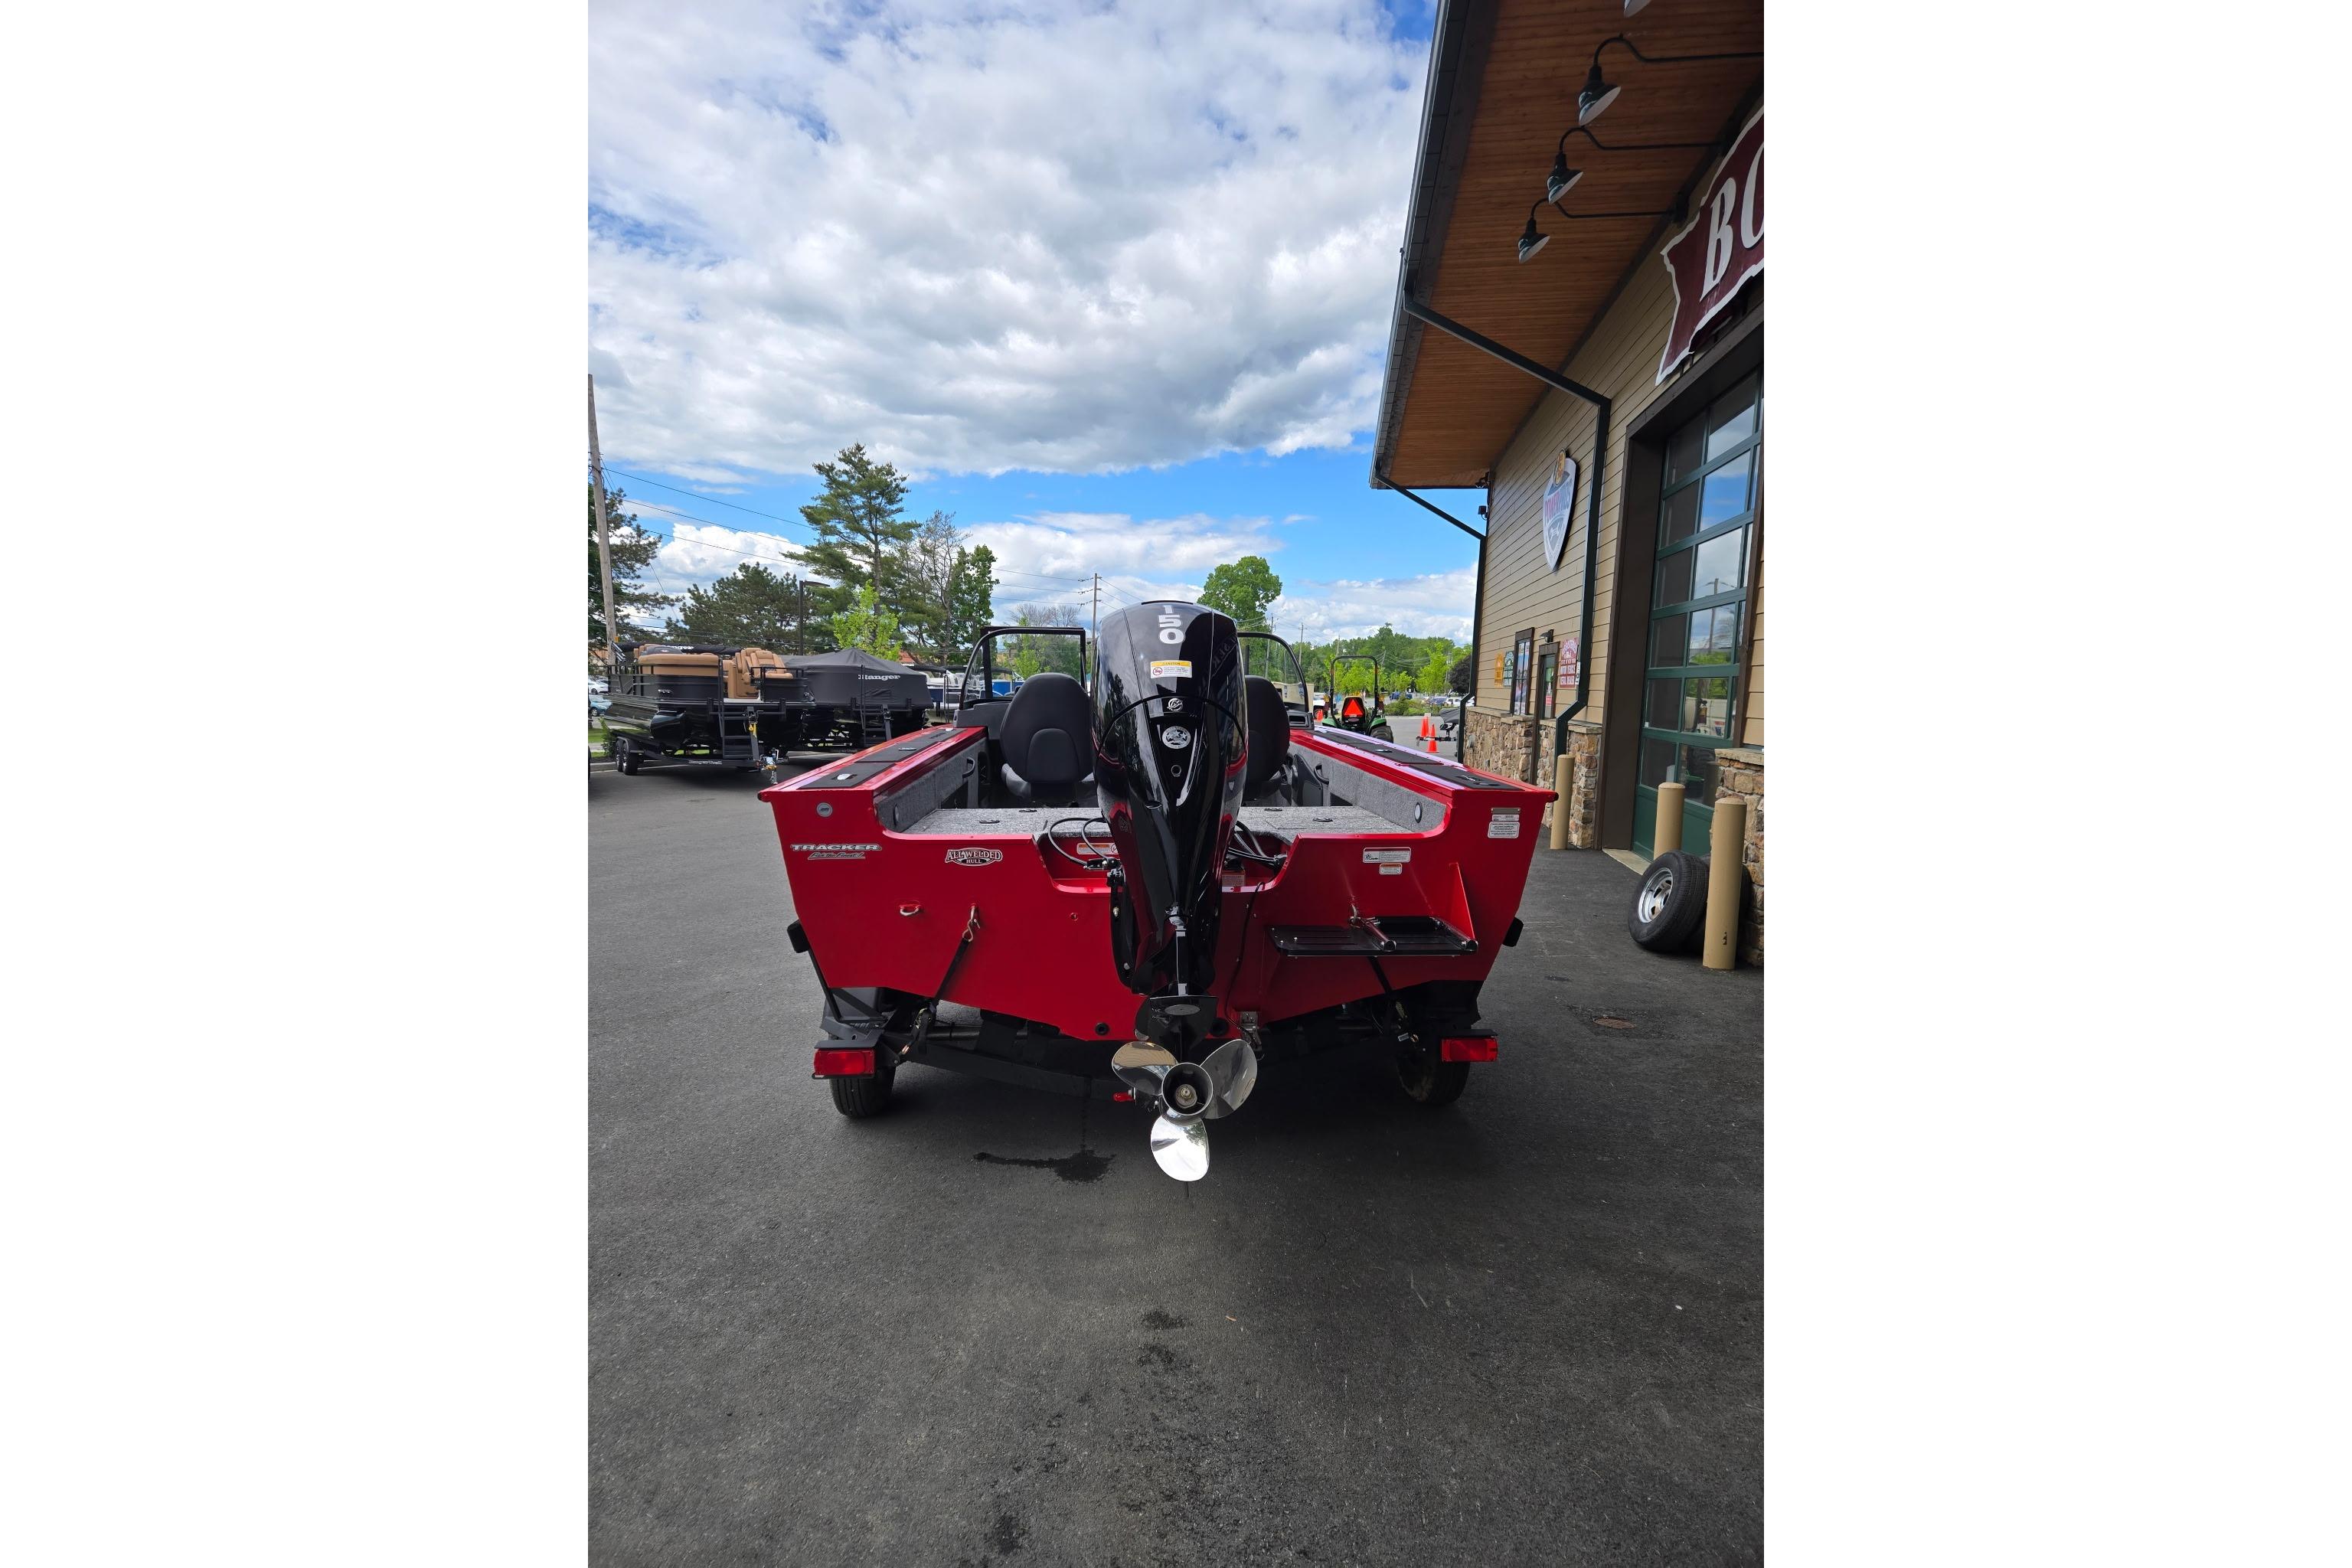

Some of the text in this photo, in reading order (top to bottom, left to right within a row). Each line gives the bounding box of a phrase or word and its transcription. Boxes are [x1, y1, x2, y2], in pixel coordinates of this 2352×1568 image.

[1158, 604, 1184, 645] 150
[947, 851, 1001, 861] ALL WELDED
